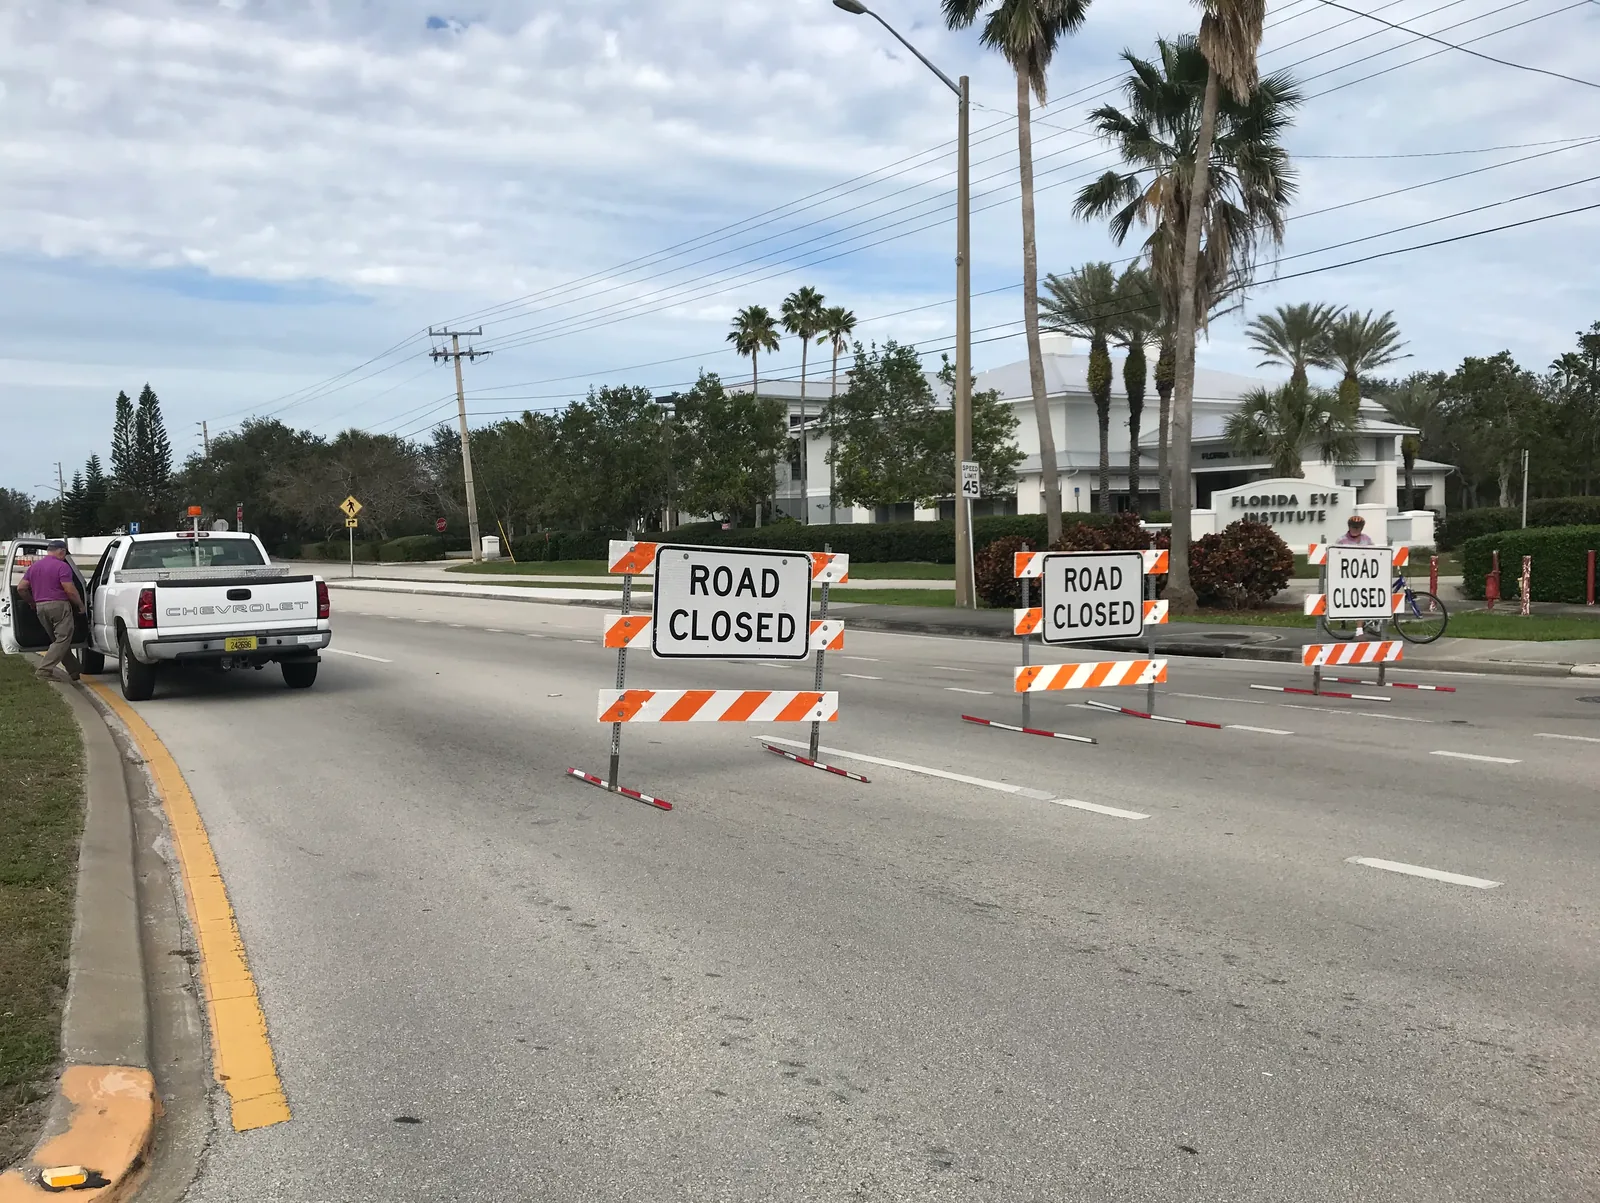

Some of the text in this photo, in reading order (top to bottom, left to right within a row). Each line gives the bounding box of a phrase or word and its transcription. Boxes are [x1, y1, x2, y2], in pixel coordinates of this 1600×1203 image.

[962, 464, 979, 472] SPEED
[963, 480, 979, 495] 45
[1231, 493, 1339, 508] FLORIDA EYE
[1242, 510, 1326, 524] INSTITUTE
[131, 523, 139, 532] H
[1341, 558, 1380, 579] ROAD
[690, 564, 780, 598] ROAD
[1064, 566, 1123, 592] ROAD
[1333, 587, 1386, 608] CLOSED
[166, 601, 309, 616] CHEVROLET
[1053, 600, 1135, 630] CLOSED
[669, 609, 796, 643] CLOSED
